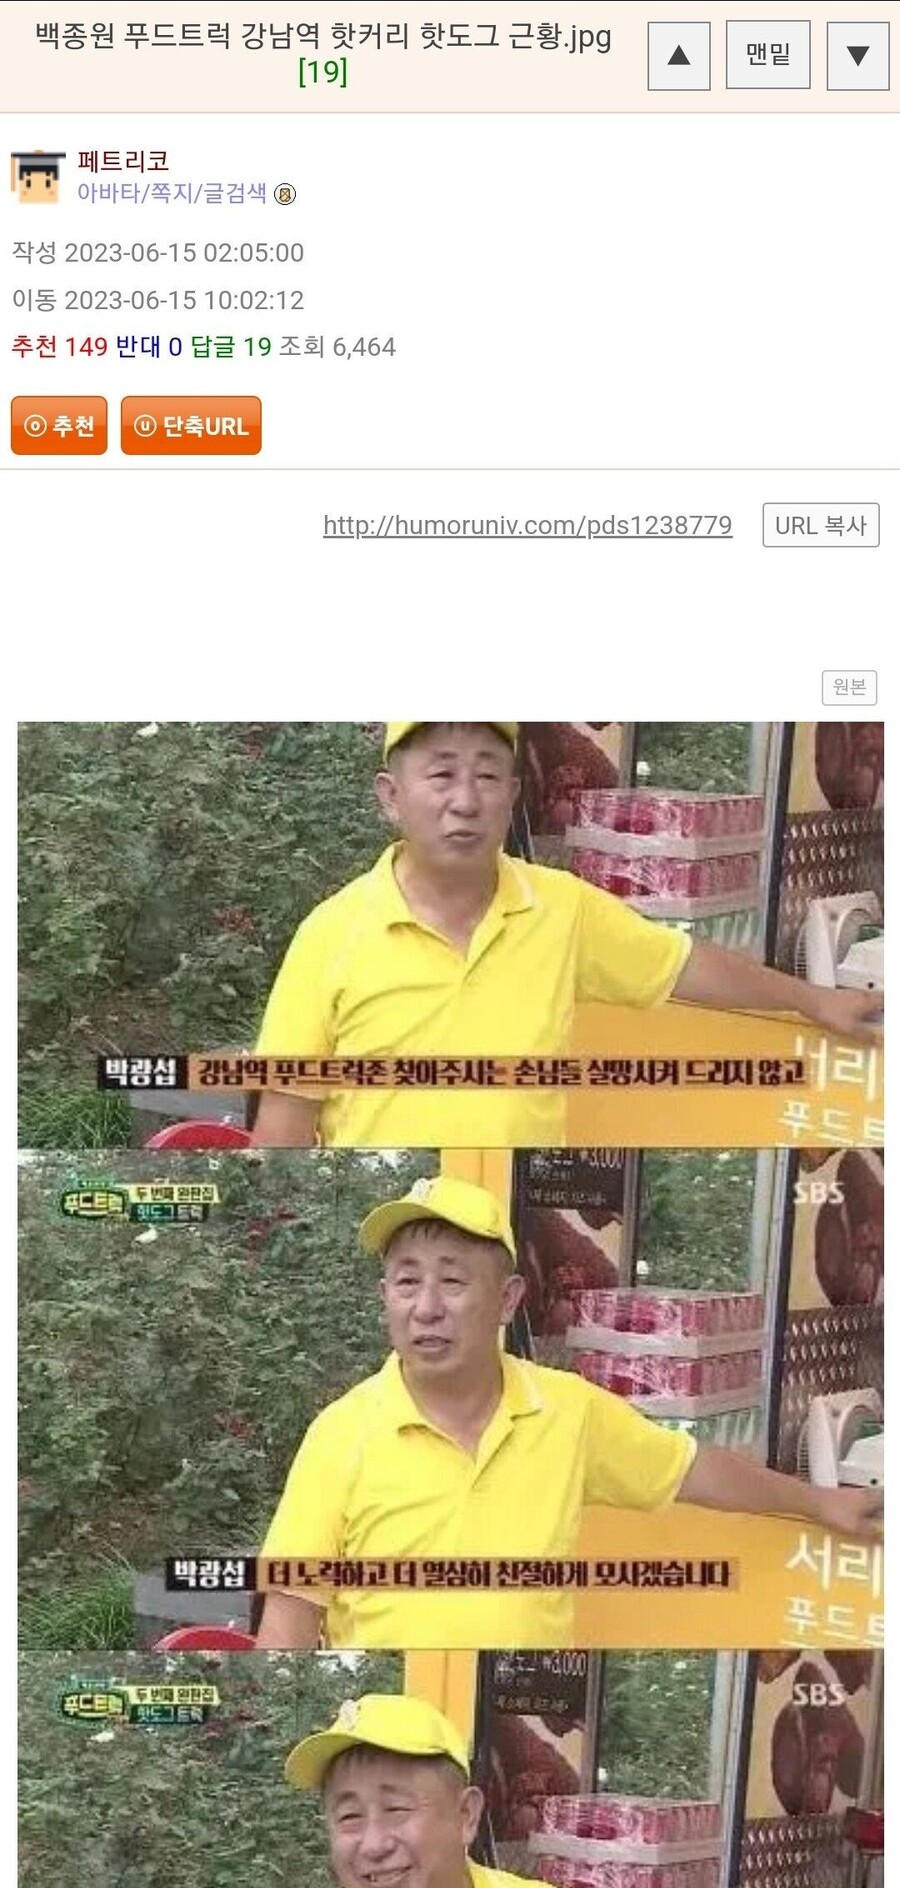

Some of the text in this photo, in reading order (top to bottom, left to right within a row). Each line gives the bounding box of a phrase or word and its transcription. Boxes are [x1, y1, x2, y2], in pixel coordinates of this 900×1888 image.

[36, 22, 611, 55] 백종원 푸드트럭 강남역 핫커리 핫도그 근황.jpg
[746, 42, 790, 66] 맨밑
[299, 56, 347, 89] [19]
[77, 150, 170, 174] 페트리코
[77, 182, 266, 205] 아바타/쪽지/글검색
[12, 241, 304, 265] 작성 2023-06-15 02:05:00
[11, 334, 397, 361] 추천 149 반대 0 답글 19 조회 6,464
[53, 415, 94, 437] 추천
[164, 415, 249, 437] 단축URL
[322, 514, 734, 540] http://humoruniv.com/pds1238779
[776, 515, 868, 537] URL 복사
[832, 678, 867, 696] 원본
